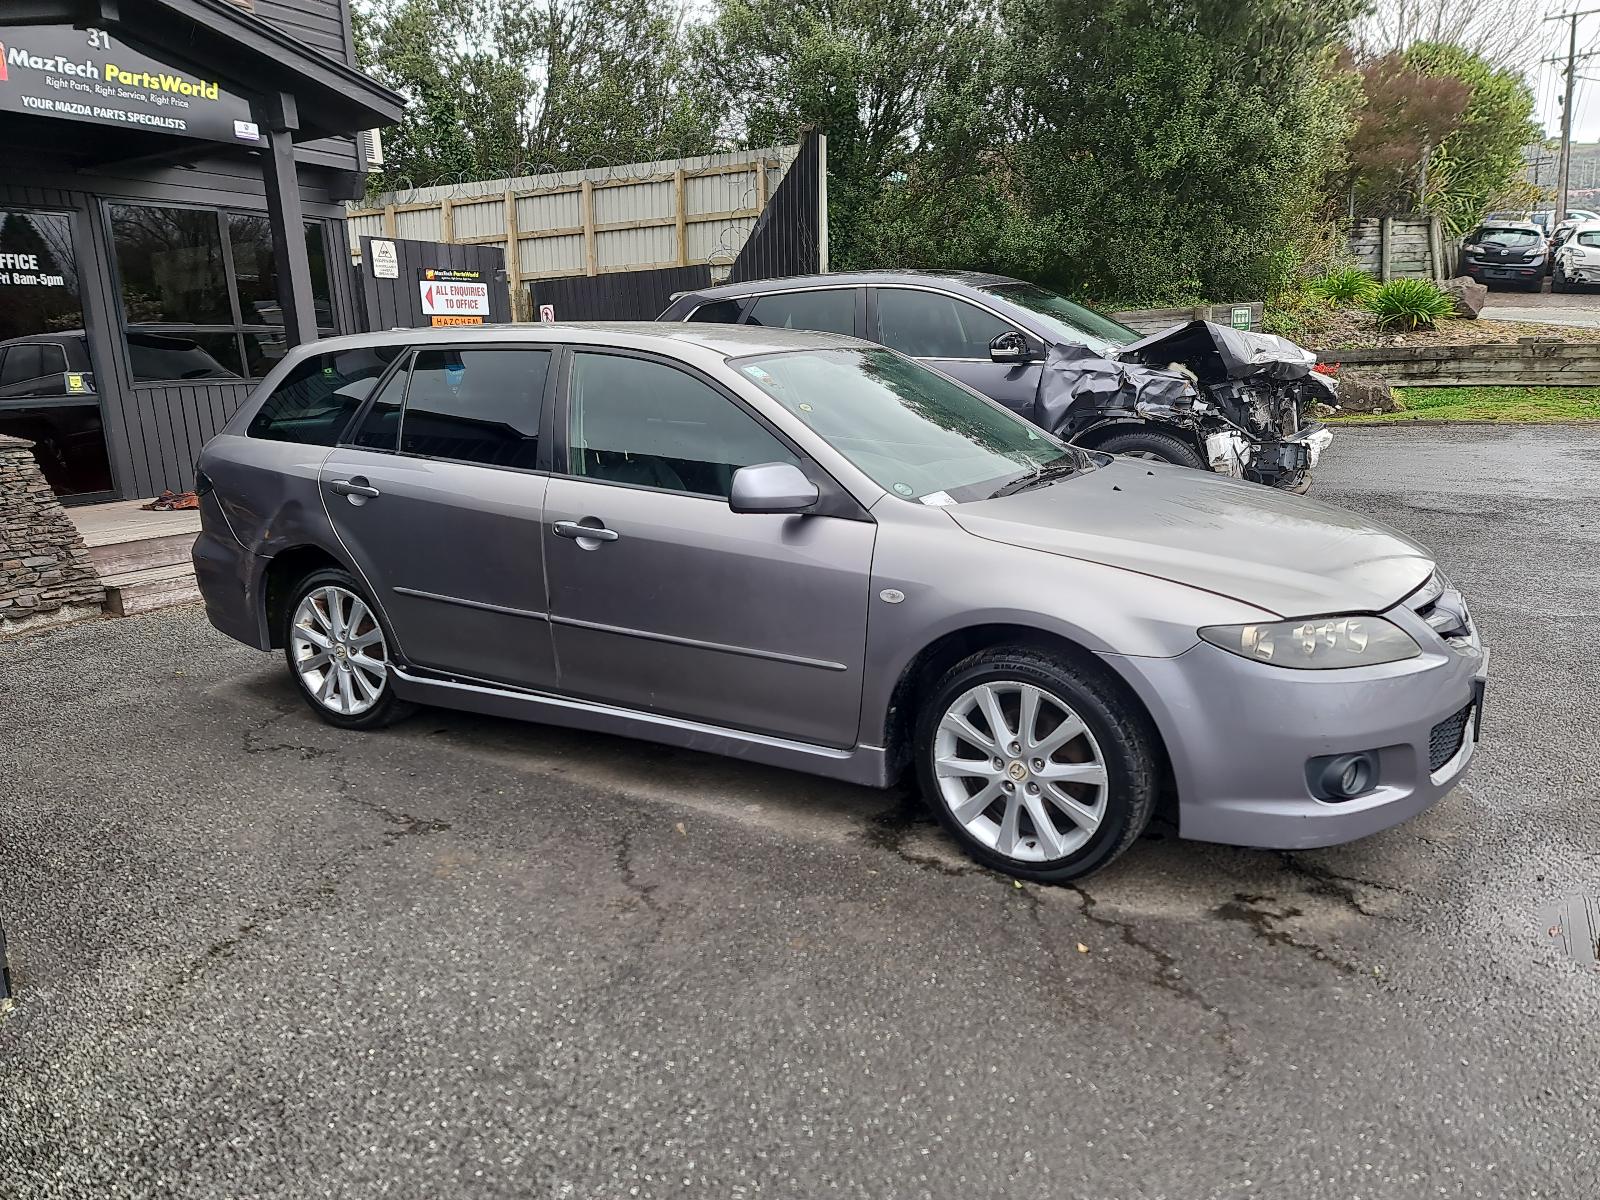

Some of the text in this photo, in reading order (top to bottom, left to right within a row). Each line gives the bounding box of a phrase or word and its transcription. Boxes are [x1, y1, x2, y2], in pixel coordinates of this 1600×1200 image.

[86, 27, 111, 50] 31
[7, 47, 219, 101] MazTech PartsWorld
[45, 75, 68, 89] Right
[69, 79, 93, 94] Parts,
[94, 83, 116, 97] Right
[117, 88, 148, 102] Service,
[150, 93, 170, 106] Right
[21, 95, 187, 131] YOUR MAZDA PARTS SPECIALISTS
[12, 272, 64, 287] 8am-5pm
[435, 285, 486, 297] ALL ENQUIRIES
[445, 298, 479, 310] TO OFFICE
